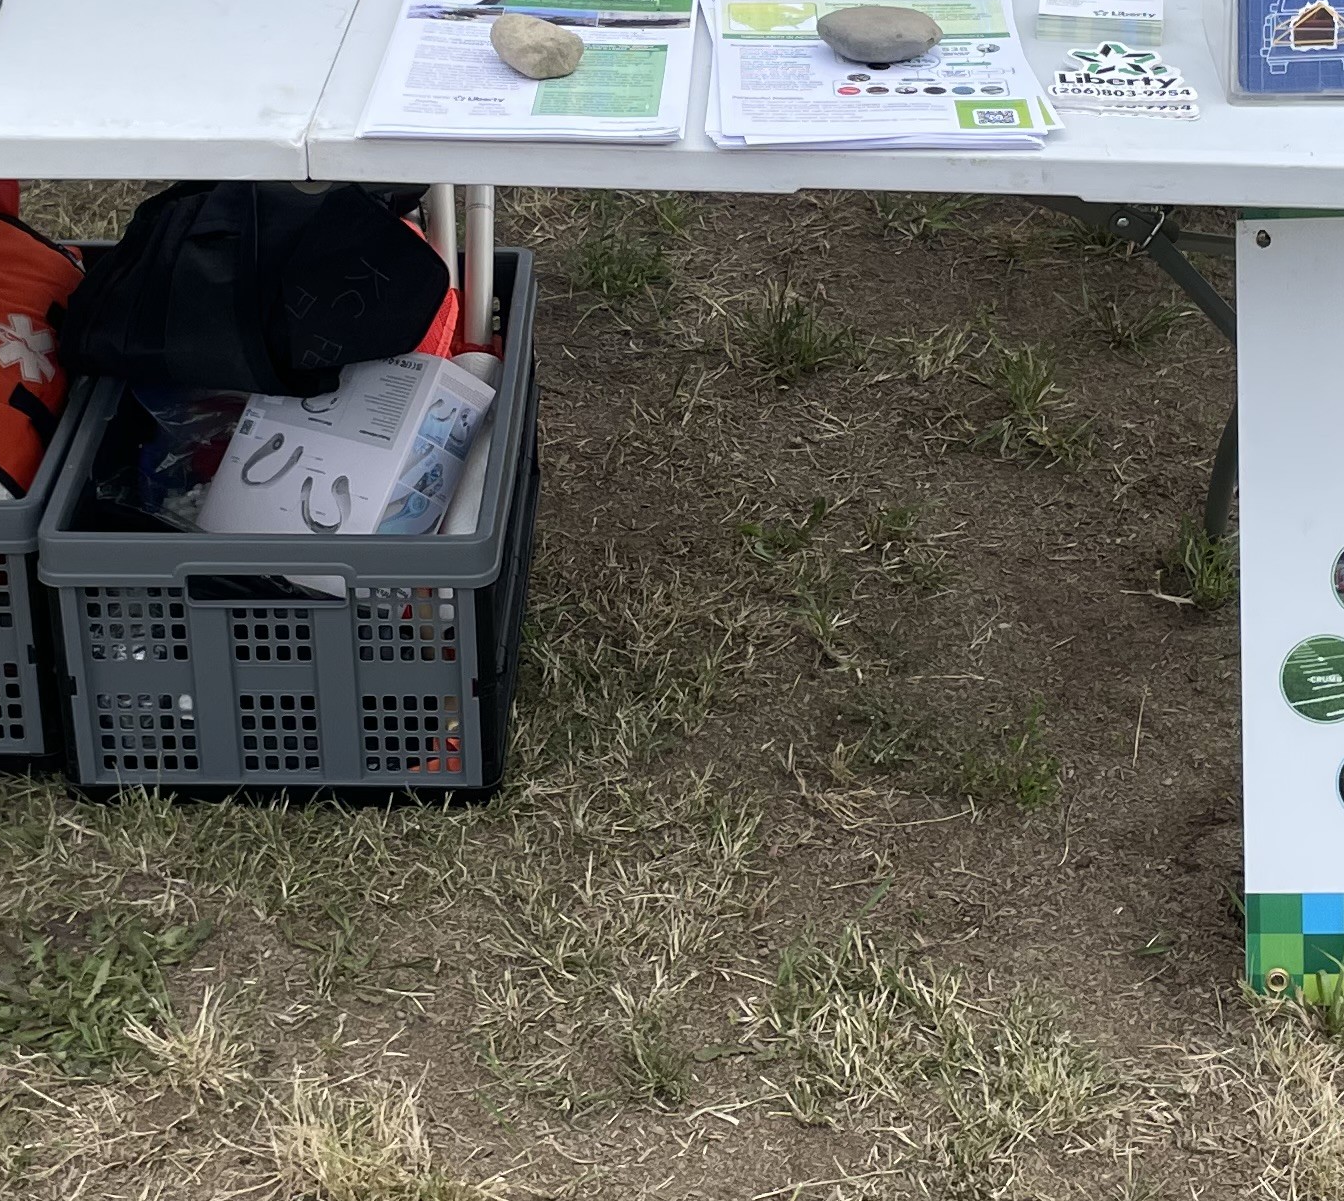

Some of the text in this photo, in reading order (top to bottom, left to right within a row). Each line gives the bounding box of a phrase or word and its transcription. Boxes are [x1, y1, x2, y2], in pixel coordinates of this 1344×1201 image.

[1111, 10, 1157, 18] Liberty
[1058, 73, 1178, 90] Liberty
[1051, 87, 1192, 98] (206)803-9954
